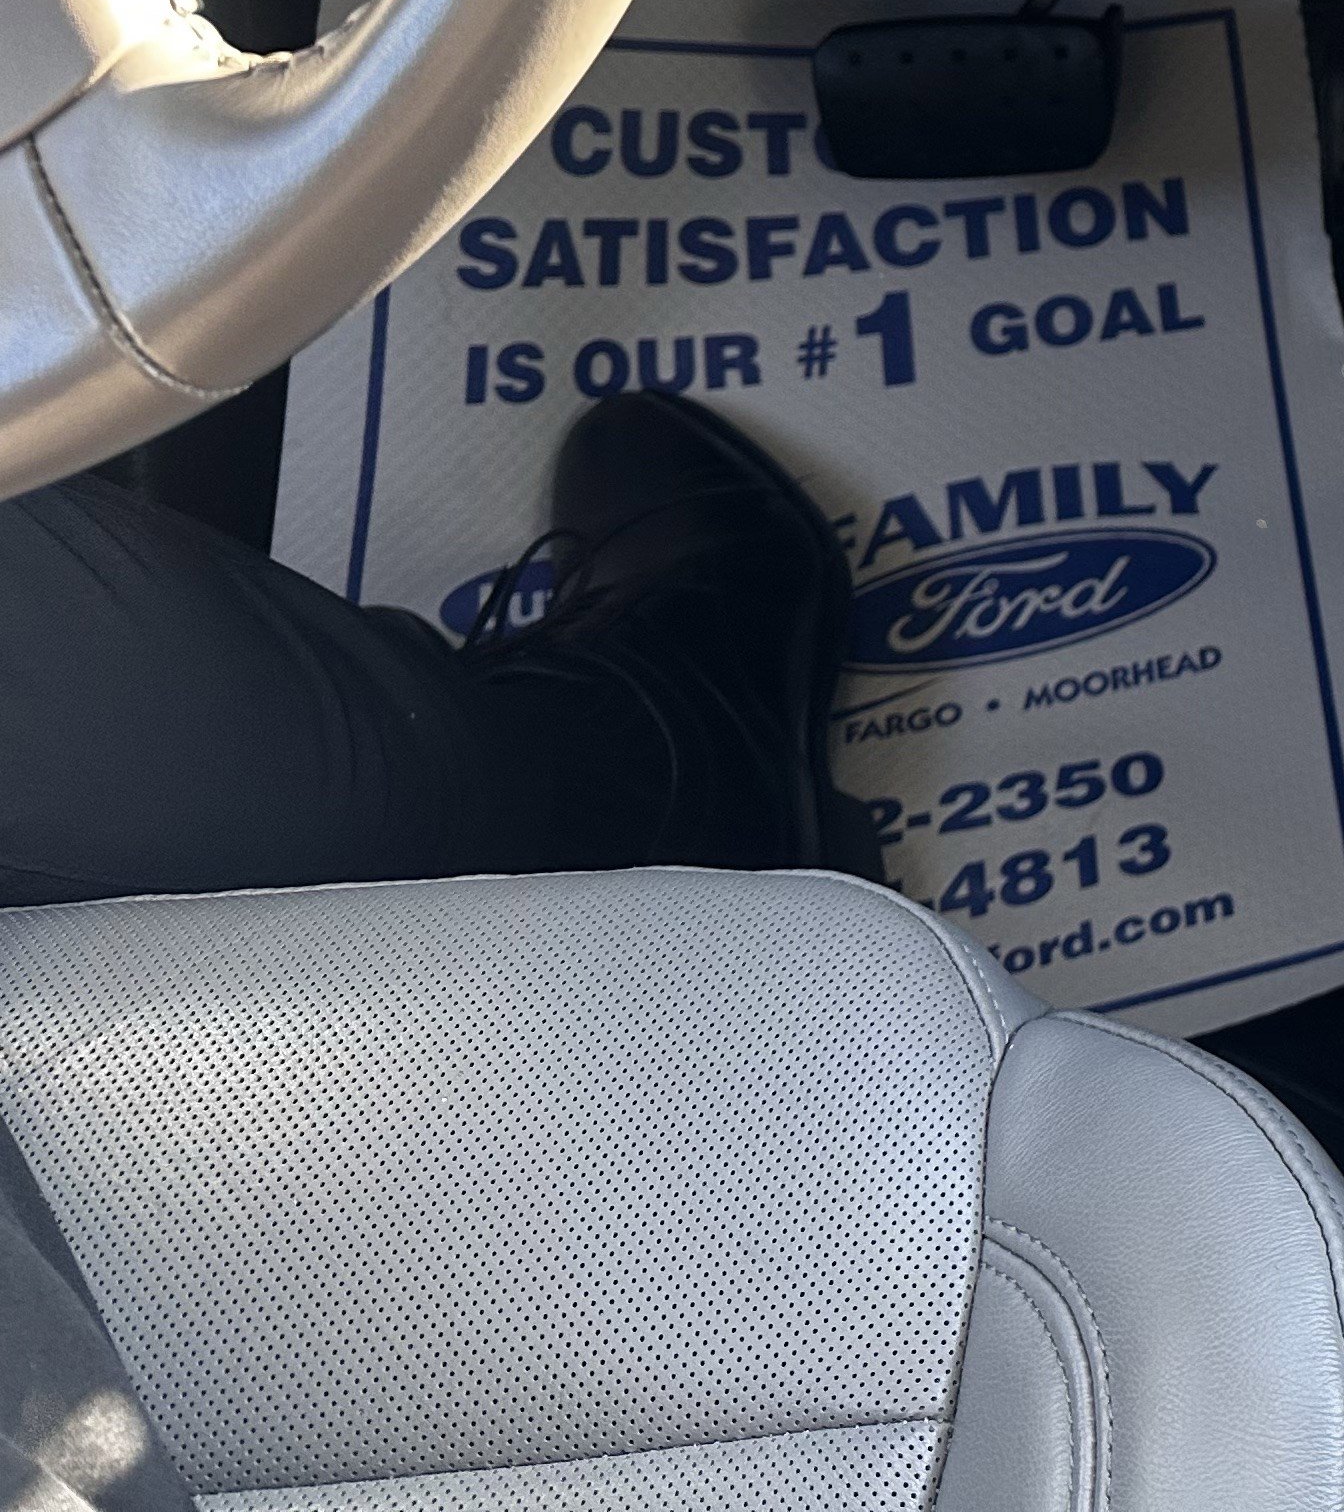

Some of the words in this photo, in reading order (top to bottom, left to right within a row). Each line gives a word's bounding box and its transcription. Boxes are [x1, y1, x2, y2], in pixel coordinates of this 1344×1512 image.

[551, 105, 846, 178] CUST
[456, 176, 1191, 289] SATISFACTION
[464, 343, 547, 405] IS
[573, 330, 763, 399] OUR
[969, 282, 1206, 358] GOAL
[835, 461, 1219, 570] AMILY
[887, 551, 1131, 654] Ford
[845, 702, 963, 745] FARGO
[1023, 645, 1222, 712] MOORHEAD
[868, 751, 1165, 846] 2-2350
[990, 892, 1235, 975] ord.com
